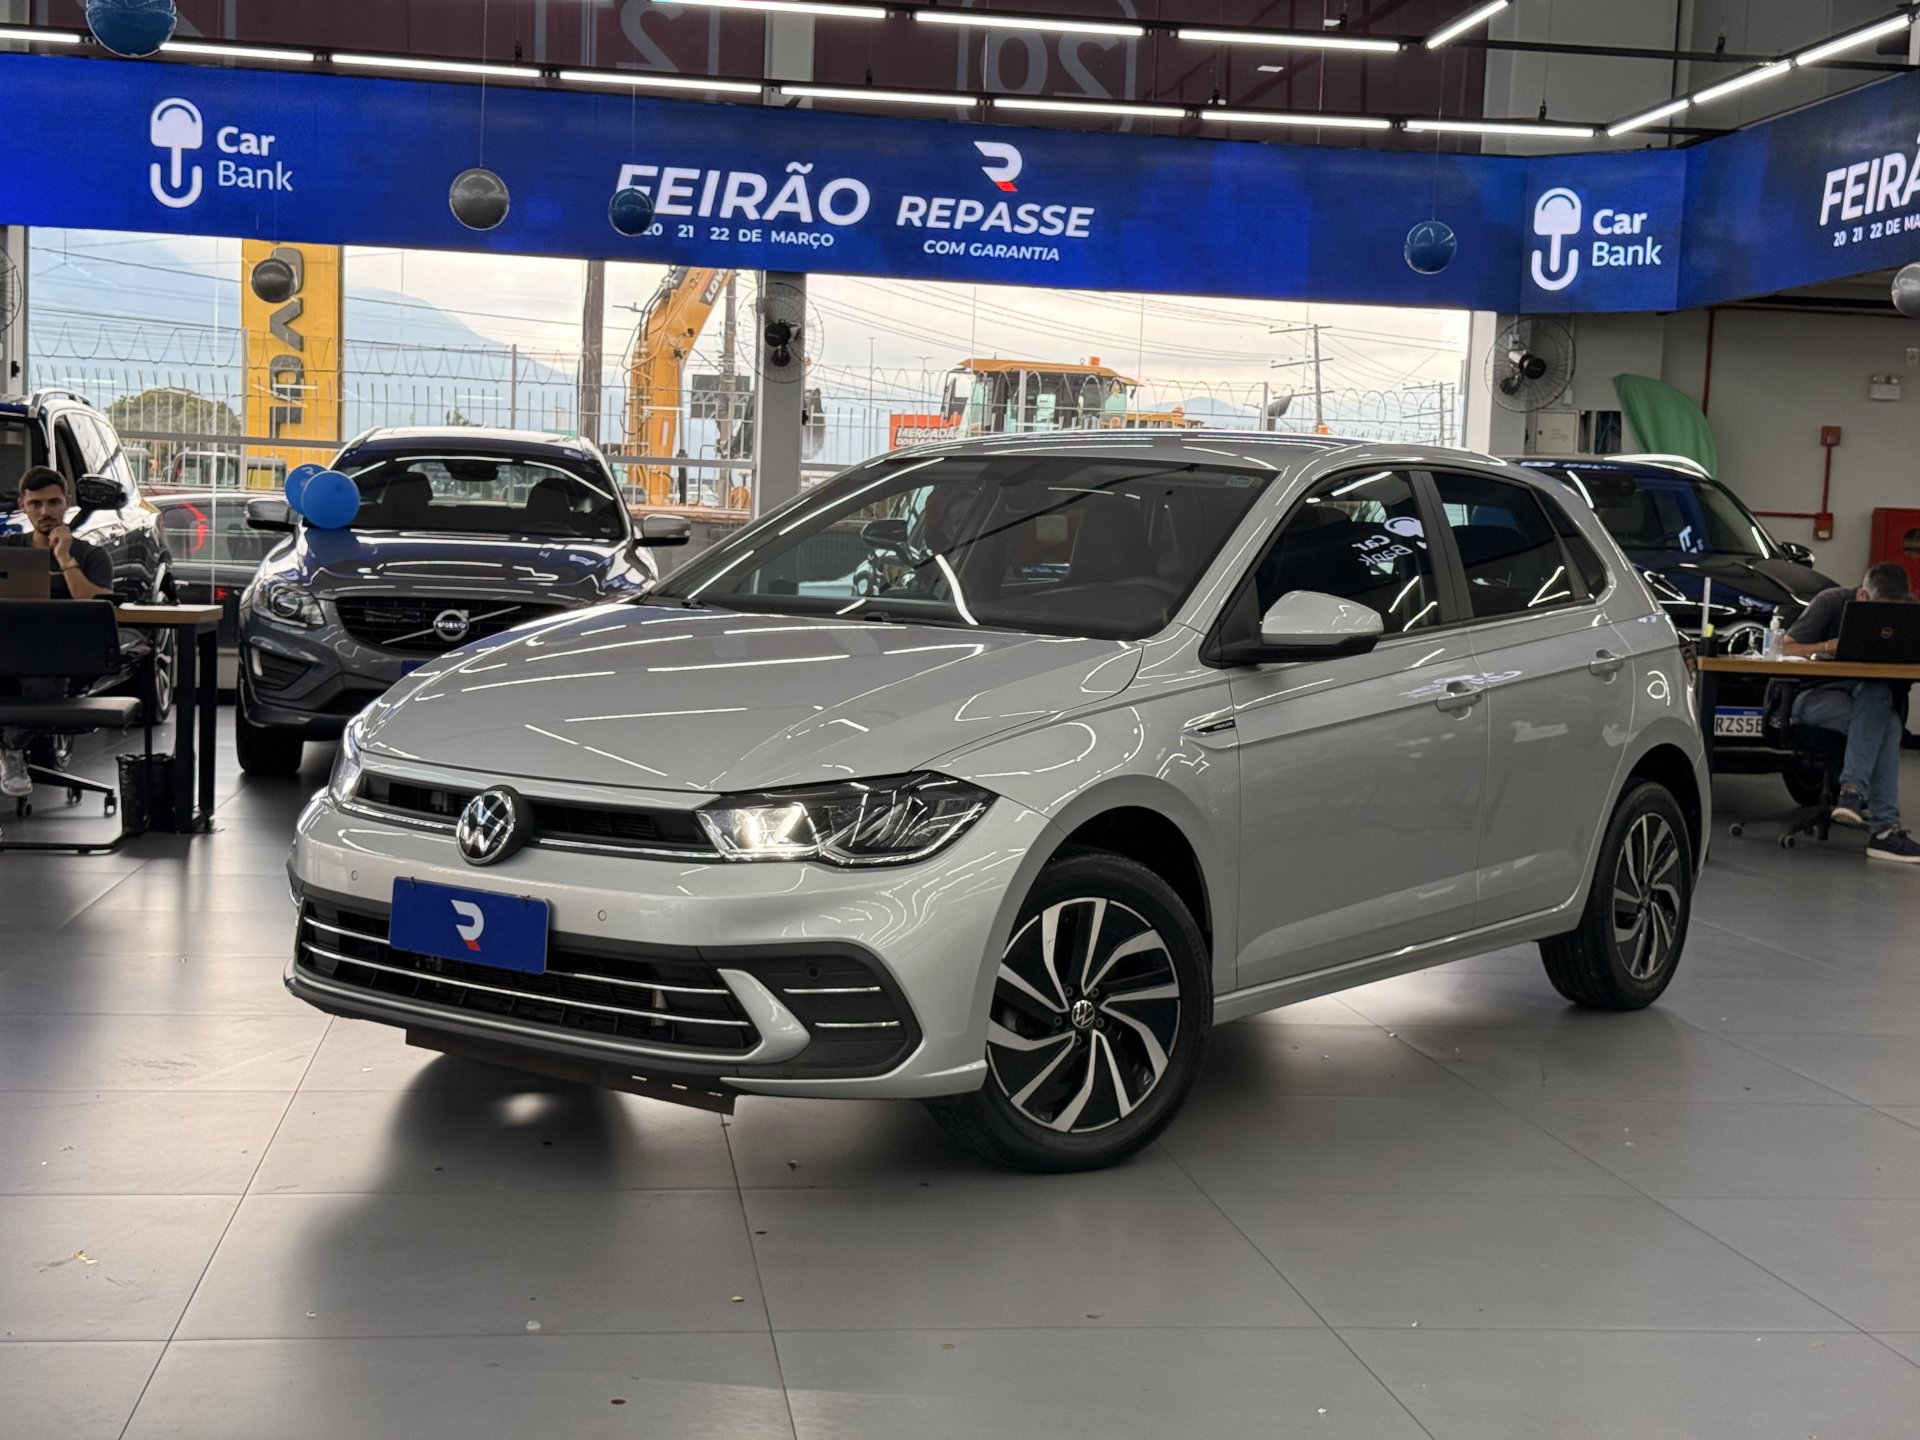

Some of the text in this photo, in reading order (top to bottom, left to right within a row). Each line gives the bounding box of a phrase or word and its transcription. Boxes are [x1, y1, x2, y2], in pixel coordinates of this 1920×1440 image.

[217, 126, 276, 156] Car
[218, 160, 293, 191] Bank
[616, 162, 871, 226] FEIRÃO
[896, 196, 1095, 237] REPASSE
[1593, 209, 1648, 235] Car
[677, 224, 694, 238] 21
[710, 226, 730, 241] 22
[738, 229, 762, 243] DE
[771, 230, 834, 249] MARÇO
[1833, 231, 1847, 247] 20
[1852, 226, 1863, 243] 21
[1870, 222, 1883, 239] 22
[1885, 217, 1901, 236] DE
[923, 240, 1060, 261] COM GARANTIA
[1592, 236, 1662, 267] Bank
[269, 243, 304, 440] OVOL
